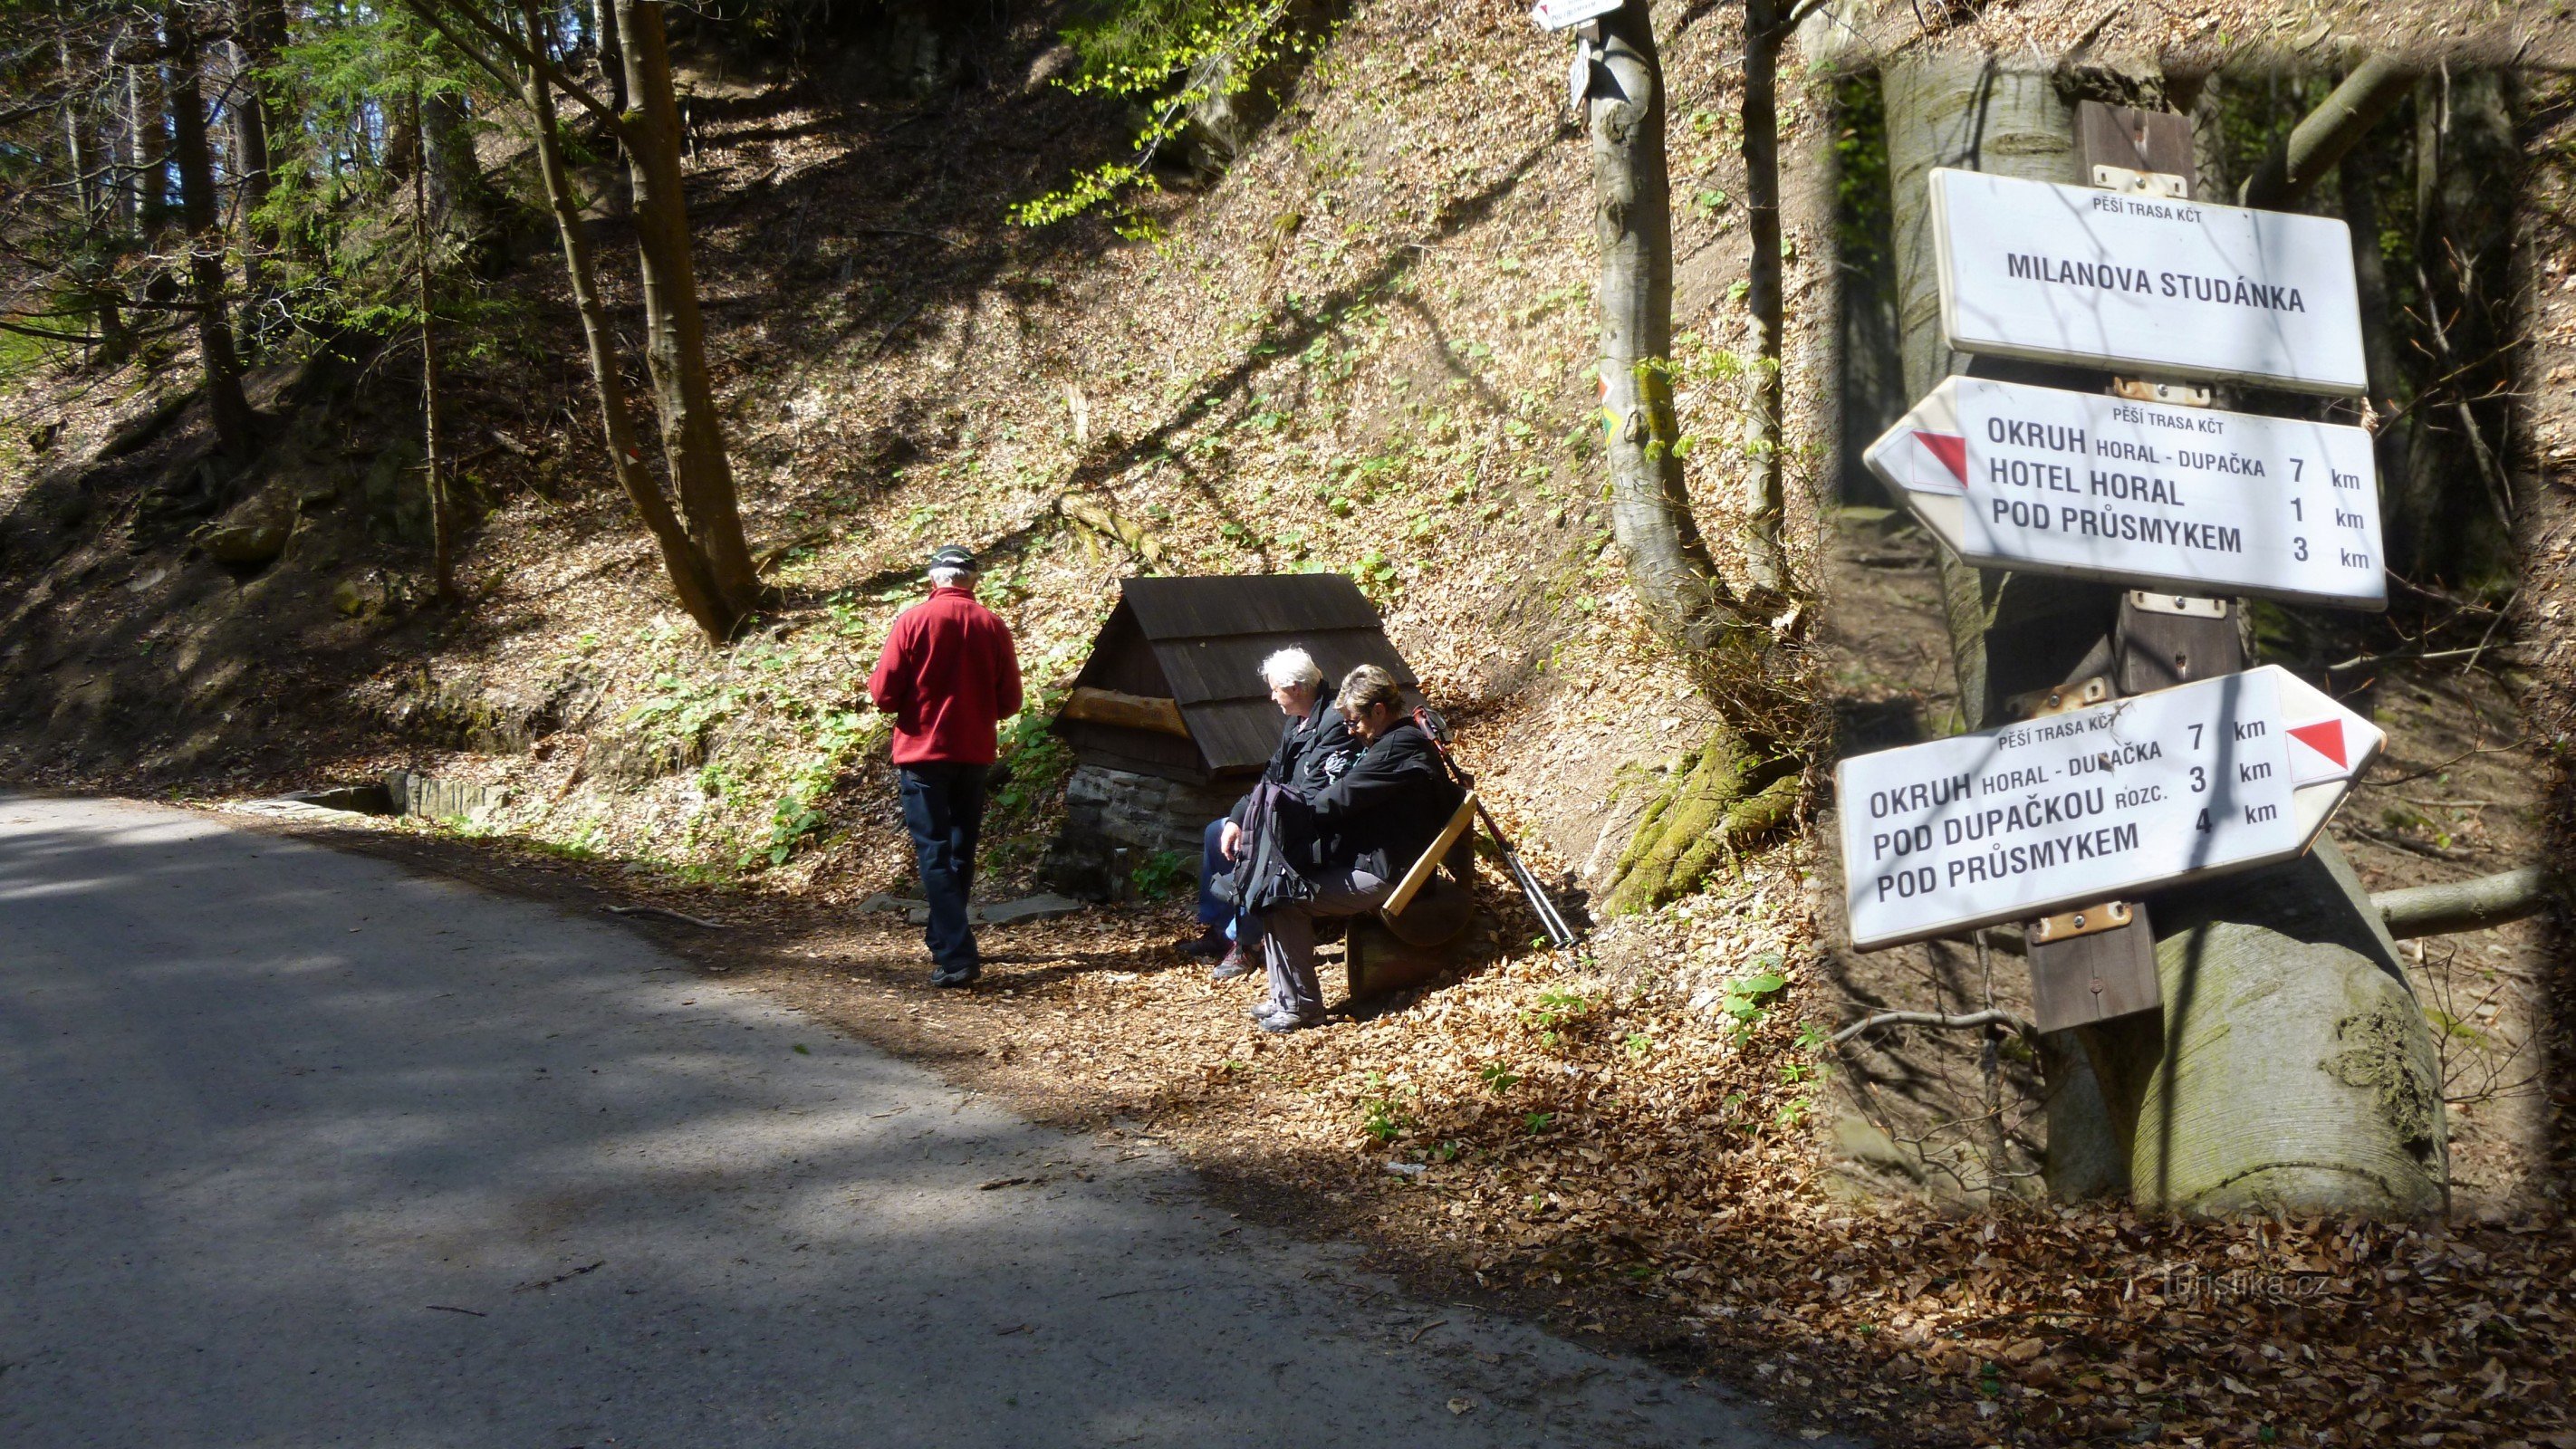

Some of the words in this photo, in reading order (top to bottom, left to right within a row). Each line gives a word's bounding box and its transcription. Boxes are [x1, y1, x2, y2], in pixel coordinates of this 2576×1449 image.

[2093, 197, 2124, 214] PĚŠÍ
[2128, 202, 2173, 219] TRASA
[2177, 206, 2202, 224] KČT
[2007, 253, 2151, 293] MILANOVA
[2161, 272, 2305, 312] STUDÁNKA
[1988, 417, 2086, 455] OKRUH
[2097, 439, 2159, 464] HORAL
[2178, 450, 2265, 477] DUPAČKA
[2289, 458, 2304, 483] 7
[2332, 469, 2360, 490] km
[2113, 405, 2144, 424] PĚŠÍ
[2148, 413, 2194, 430] TRASA
[2198, 416, 2225, 435] KČT
[1991, 458, 2081, 494] HOTEL
[2091, 472, 2185, 506] HORAL
[2290, 497, 2302, 522] 1
[2337, 508, 2364, 530] km
[1993, 499, 2050, 529] POD
[2062, 504, 2241, 553] PRŮSMYKEM
[2293, 537, 2309, 561] 3
[2341, 548, 2369, 569] km
[1870, 773, 1973, 819] OKRUH
[1983, 766, 2049, 796] HORAL
[2187, 724, 2203, 750] 7
[2235, 718, 2265, 742] km
[1998, 728, 2032, 751] PĚŠÍ
[2034, 721, 2085, 744] TRASA
[1874, 824, 1933, 860] POD
[1945, 787, 2104, 846] DUPAČKOU
[2116, 785, 2167, 810] ROZC.
[2190, 766, 2206, 792] 3
[2240, 759, 2272, 782] km
[1877, 865, 1937, 902] POD
[1949, 821, 2139, 888] PRŮSMYKEM
[2195, 808, 2212, 834] 4
[2245, 802, 2277, 825] km
